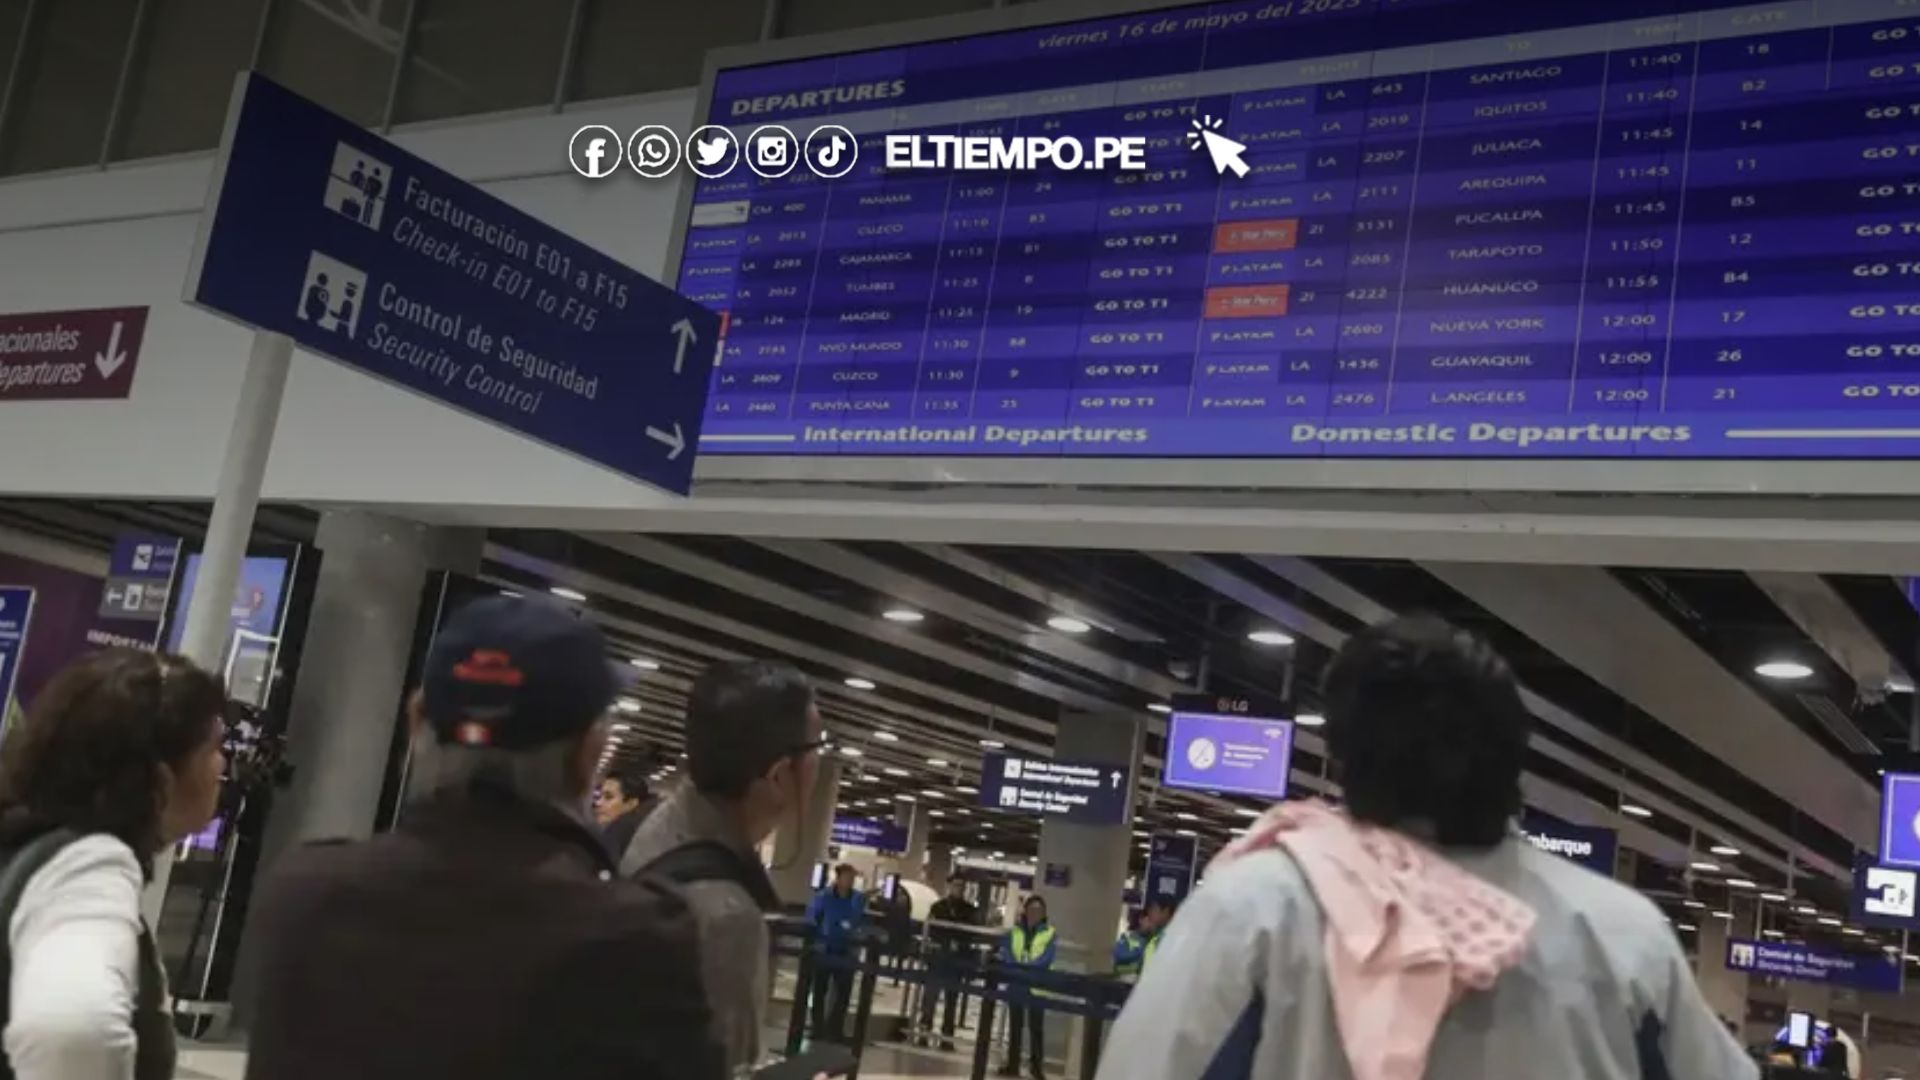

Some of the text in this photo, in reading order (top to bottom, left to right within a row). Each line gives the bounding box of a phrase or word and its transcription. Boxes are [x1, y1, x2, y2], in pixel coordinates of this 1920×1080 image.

[1037, 30, 1109, 49] viernes
[1118, 24, 1145, 39] 16
[1151, 20, 1177, 34] de
[1184, 12, 1249, 32] mayo
[1255, 3, 1293, 21] del
[1871, 27, 1908, 41] GO
[1628, 53, 1682, 68] 11:40
[1469, 65, 1563, 85] SANTIAGO
[1868, 64, 1905, 78] GO
[730, 79, 907, 116] DEPARTURES
[1325, 89, 1346, 101] LA
[1625, 88, 1679, 103] 11:40
[1123, 109, 1148, 122] GO
[1151, 107, 1174, 118] TO
[1473, 100, 1548, 118] IQUITOS
[1864, 106, 1902, 120] GO
[1321, 120, 1342, 133] LA
[1739, 119, 1762, 131] 14
[1621, 126, 1673, 141] 11:45
[1472, 138, 1542, 156] JULIACA
[1861, 146, 1898, 159] GO
[1317, 156, 1337, 168] LA
[1363, 149, 1406, 164] 2207
[1735, 158, 1757, 171] 11
[1142, 172, 1164, 182] TO
[1616, 165, 1670, 179] 11:45
[1458, 174, 1547, 192] AREQUIPA
[1312, 190, 1333, 202] LA
[1359, 185, 1399, 198] 2111
[1858, 184, 1896, 198] GO
[858, 193, 913, 206] PANAMA
[1108, 206, 1133, 217] GO
[1137, 203, 1159, 214] TO
[1613, 200, 1667, 215] 11:45
[1454, 208, 1544, 226] PUCALLPA
[857, 223, 904, 236] CUZCO
[1854, 223, 1893, 237] GO
[403, 176, 630, 310] Facturación E01 a F15
[1103, 237, 1129, 248] GO
[1132, 234, 1155, 246] TO
[1610, 237, 1665, 252] 11:50
[1727, 231, 1753, 245] 12
[838, 251, 913, 266] CAJAMARCA
[1446, 243, 1543, 261] TARAPOTO
[1304, 257, 1324, 269] LA
[392, 214, 601, 334] Check-in E01 to F15
[1099, 269, 1124, 280] GO
[1127, 266, 1151, 278] TO
[1852, 263, 1890, 278] GO
[845, 281, 896, 293] TUMBES
[1442, 278, 1540, 297] HUANUCO
[1606, 274, 1659, 288] 11:55
[1345, 286, 1389, 300] 4222
[1093, 300, 1119, 312] GO
[1122, 299, 1146, 310] TO
[1848, 304, 1887, 319] GO
[838, 311, 892, 323] MADRID
[1601, 313, 1656, 328] 12:00
[1720, 310, 1746, 324] 17
[1294, 326, 1315, 338] LA
[1430, 317, 1545, 333] NUEVA YORK
[378, 282, 600, 400] Control de Seguridad
[1089, 333, 1115, 345] GO
[1118, 331, 1141, 343] TO
[849, 340, 903, 352] MUNDO
[1845, 343, 1883, 358] GO
[1430, 354, 1534, 368] GUAYAQUIL
[1599, 352, 1653, 366] 12:00
[1715, 349, 1742, 363] 26
[367, 322, 545, 415] Security Control
[1084, 364, 1110, 377] GO
[1112, 363, 1136, 375] TO
[1289, 359, 1311, 372] LA
[1338, 357, 1380, 371] 1436
[720, 374, 736, 385] LA
[831, 370, 879, 383] CUZCO
[1594, 388, 1650, 402] 12:00
[1711, 386, 1737, 401] 21
[1842, 384, 1881, 399] GO
[809, 400, 892, 412] PUNTA CANA
[1079, 397, 1105, 409] GO
[1108, 396, 1132, 408] TO
[1285, 393, 1306, 406] LA
[1331, 392, 1375, 406] 2476
[715, 403, 731, 414] LA
[803, 424, 1148, 446] International Departures
[1290, 422, 1692, 447] Domestic Departures
